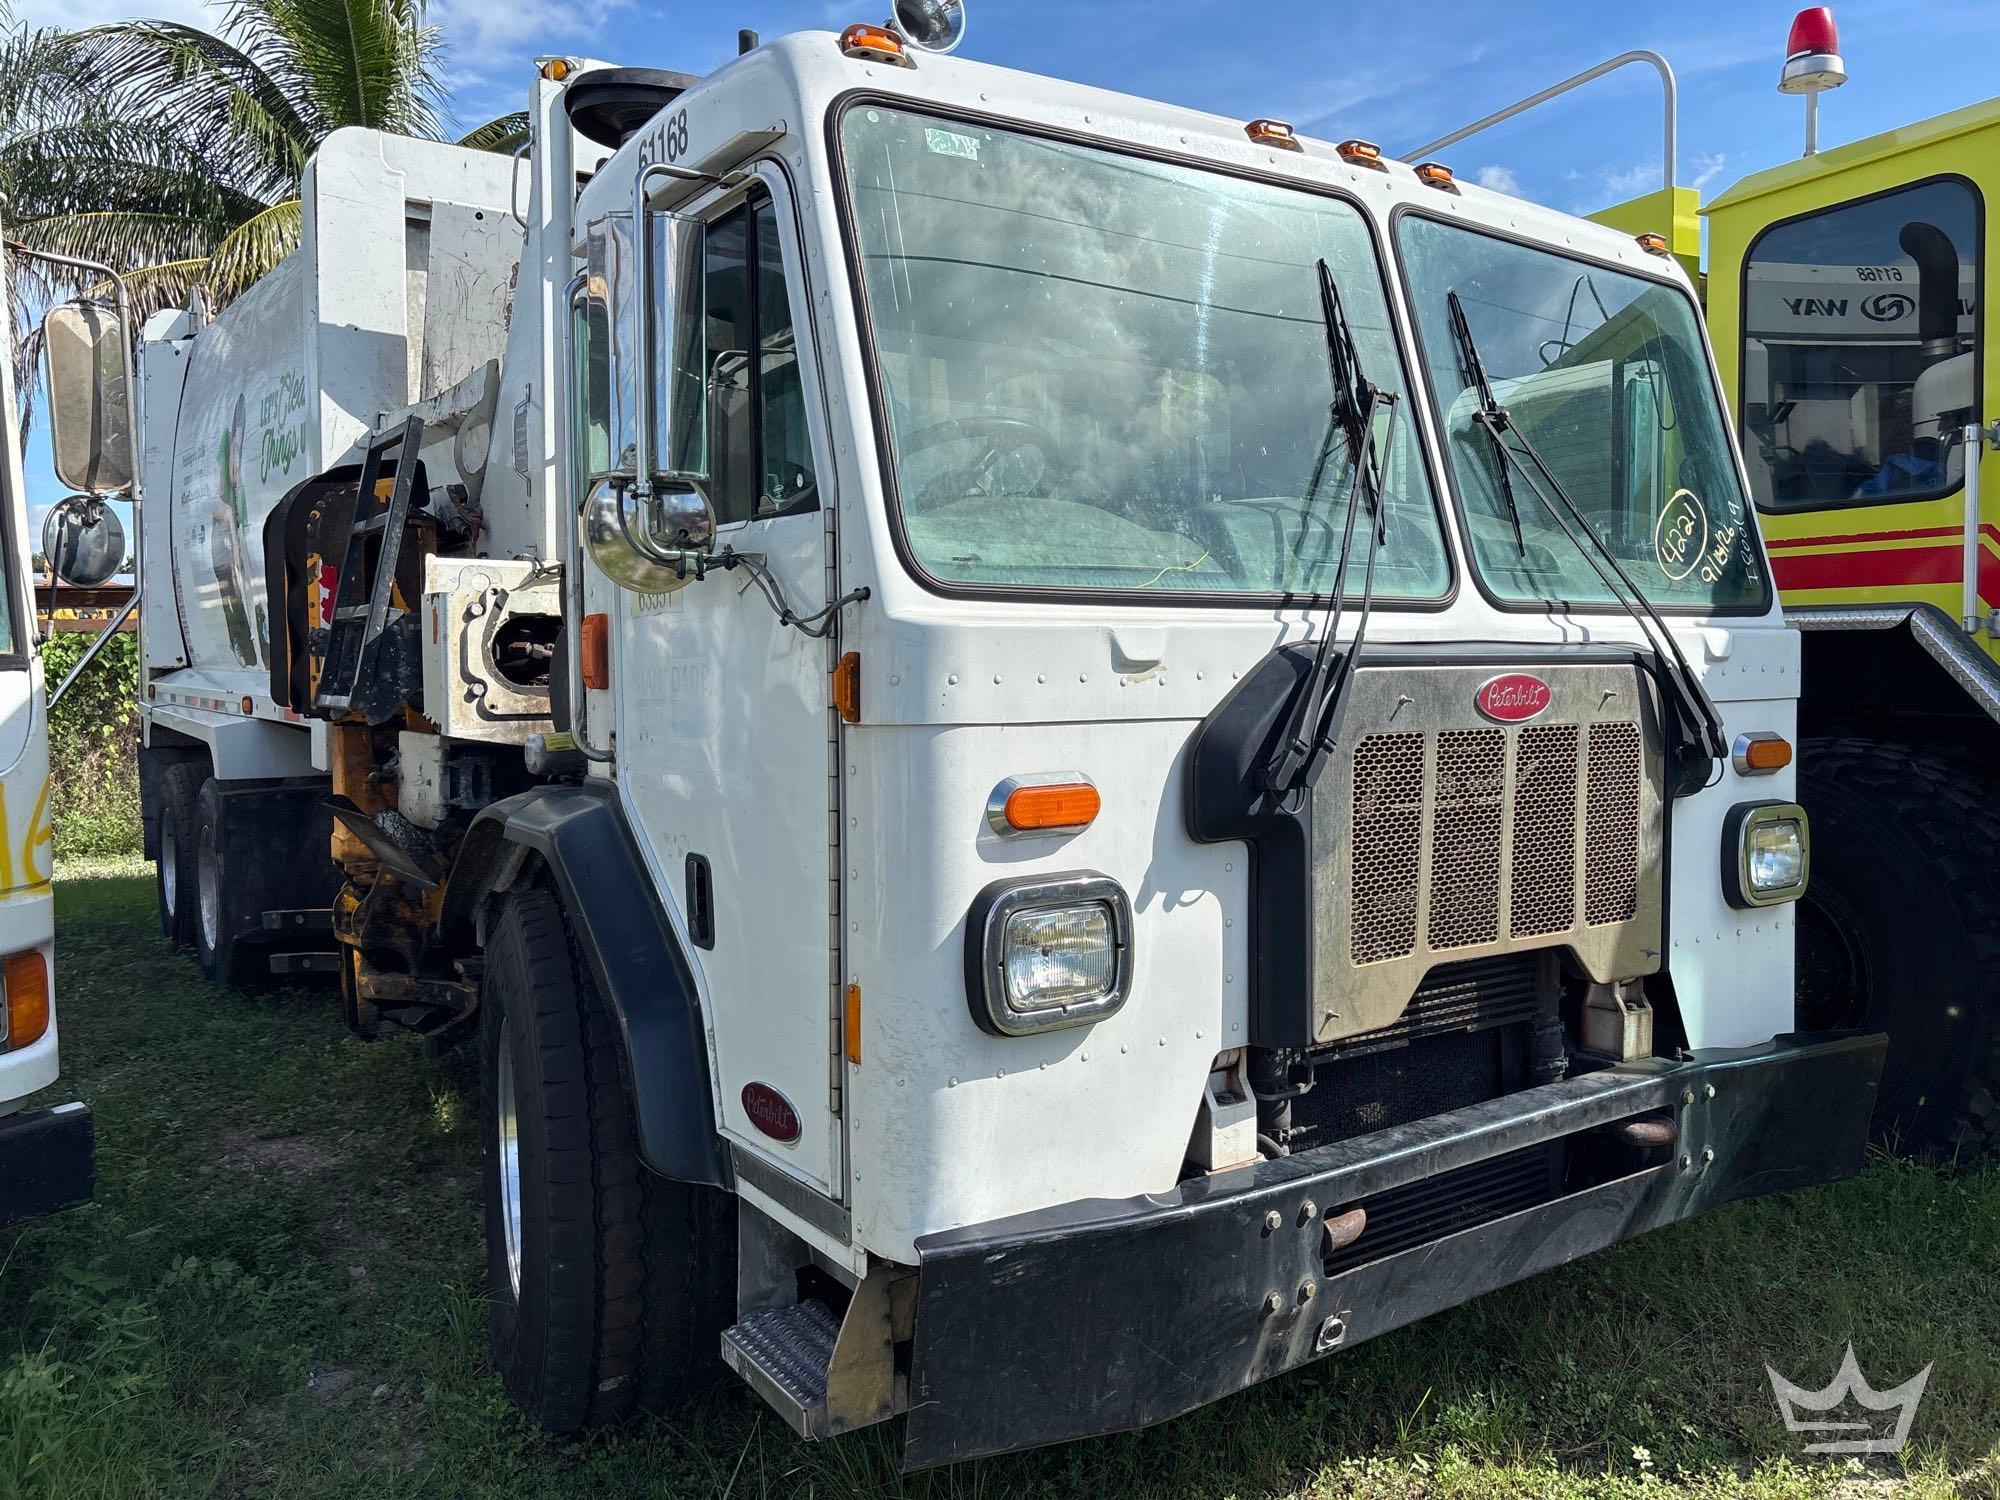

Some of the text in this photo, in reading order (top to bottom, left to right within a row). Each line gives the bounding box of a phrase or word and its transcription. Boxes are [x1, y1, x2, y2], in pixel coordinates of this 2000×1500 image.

[638, 108, 689, 169] 61168
[1661, 502, 1697, 563] 4221
[1487, 682, 1546, 711] Peterbilt
[747, 1086, 792, 1130] Peterbilt
